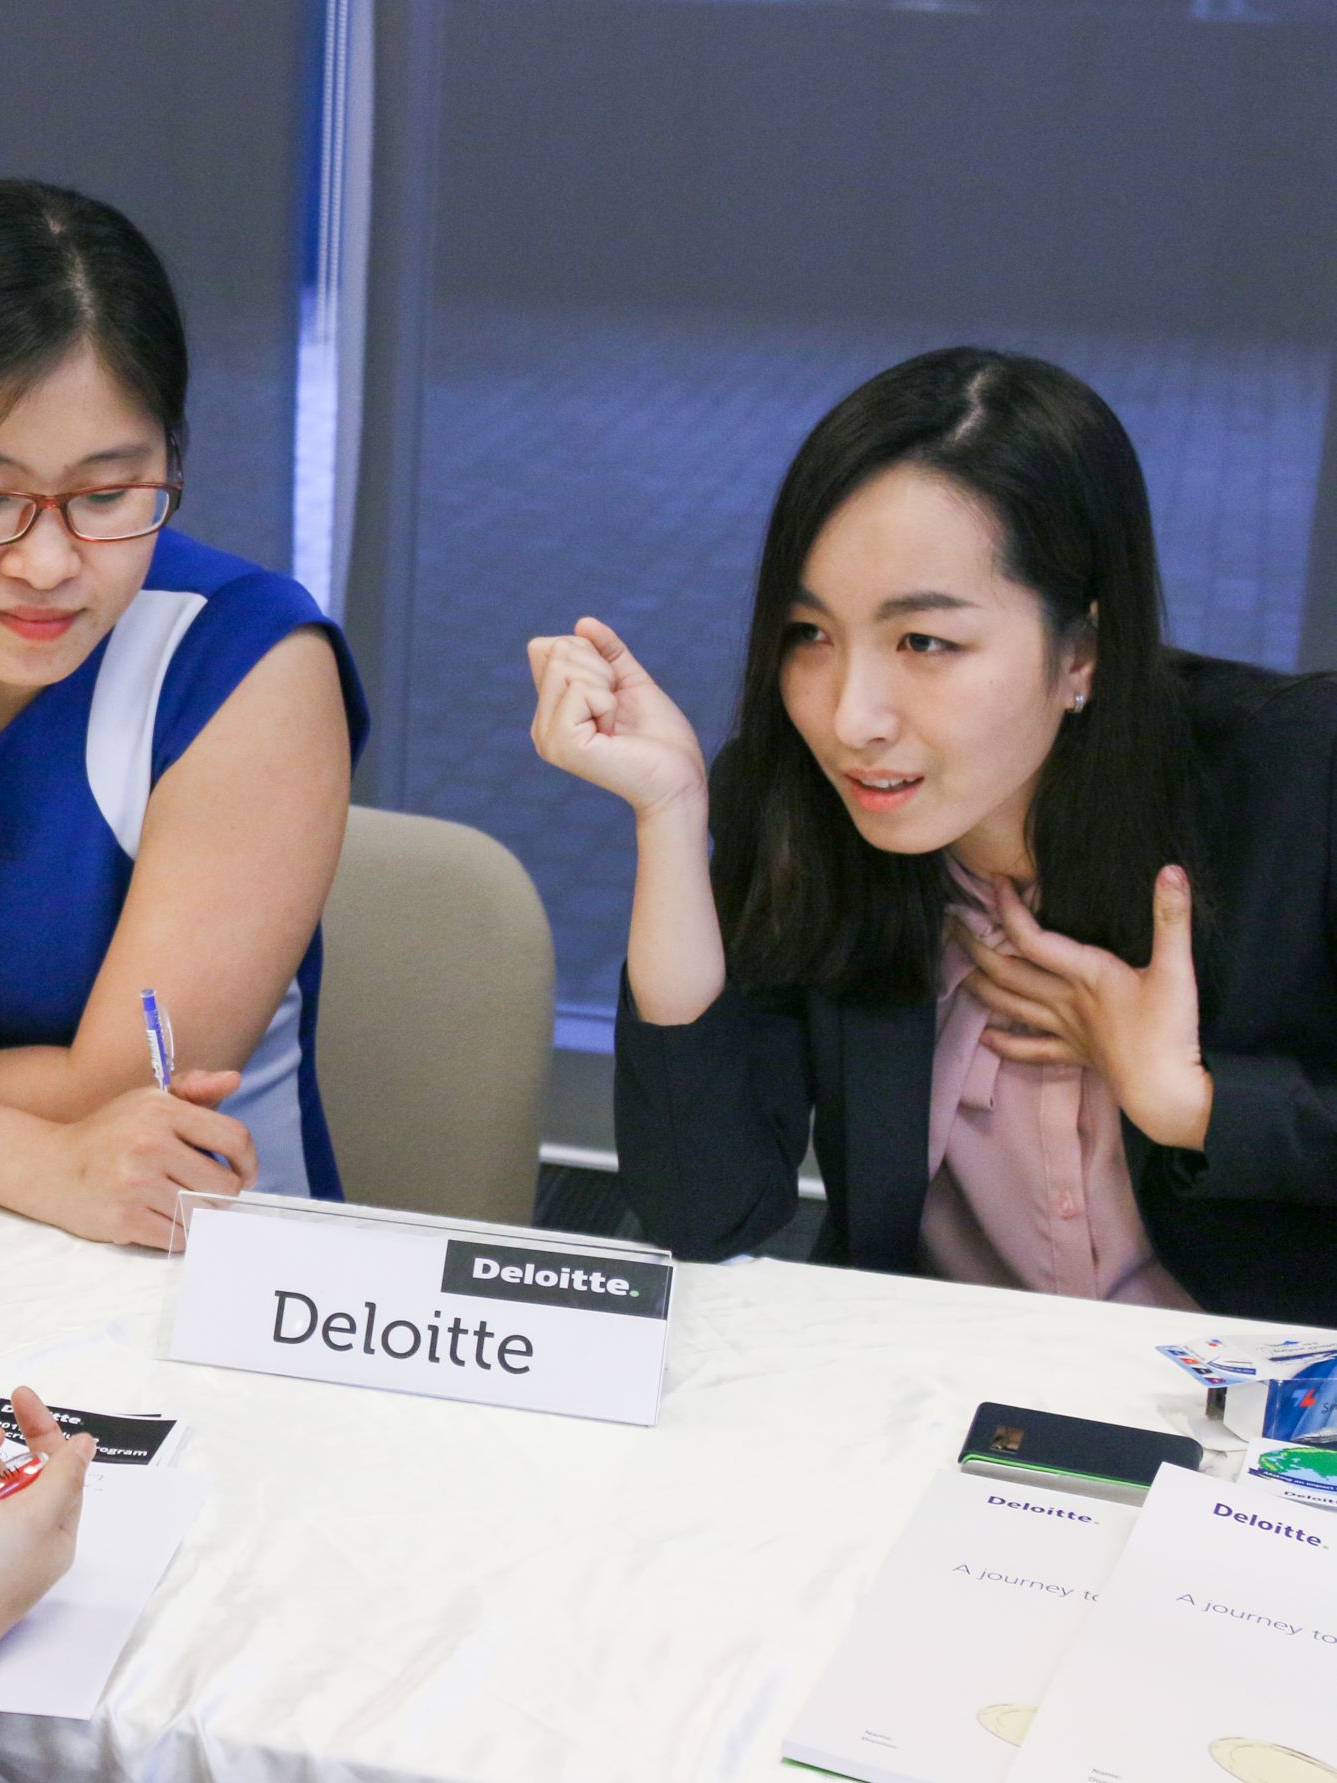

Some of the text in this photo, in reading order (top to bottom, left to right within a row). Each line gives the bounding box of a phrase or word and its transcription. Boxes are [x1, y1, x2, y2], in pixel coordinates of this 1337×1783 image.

[472, 1257, 640, 1298] Deloitte.
[272, 1289, 534, 1375] Deloitte
[95, 1445, 148, 1458] rogram
[1213, 1502, 1330, 1550] Deloitte.
[952, 1563, 971, 1575] A
[977, 1568, 1074, 1598] journey
[1176, 1593, 1195, 1606] A
[1201, 1599, 1303, 1636] journey
